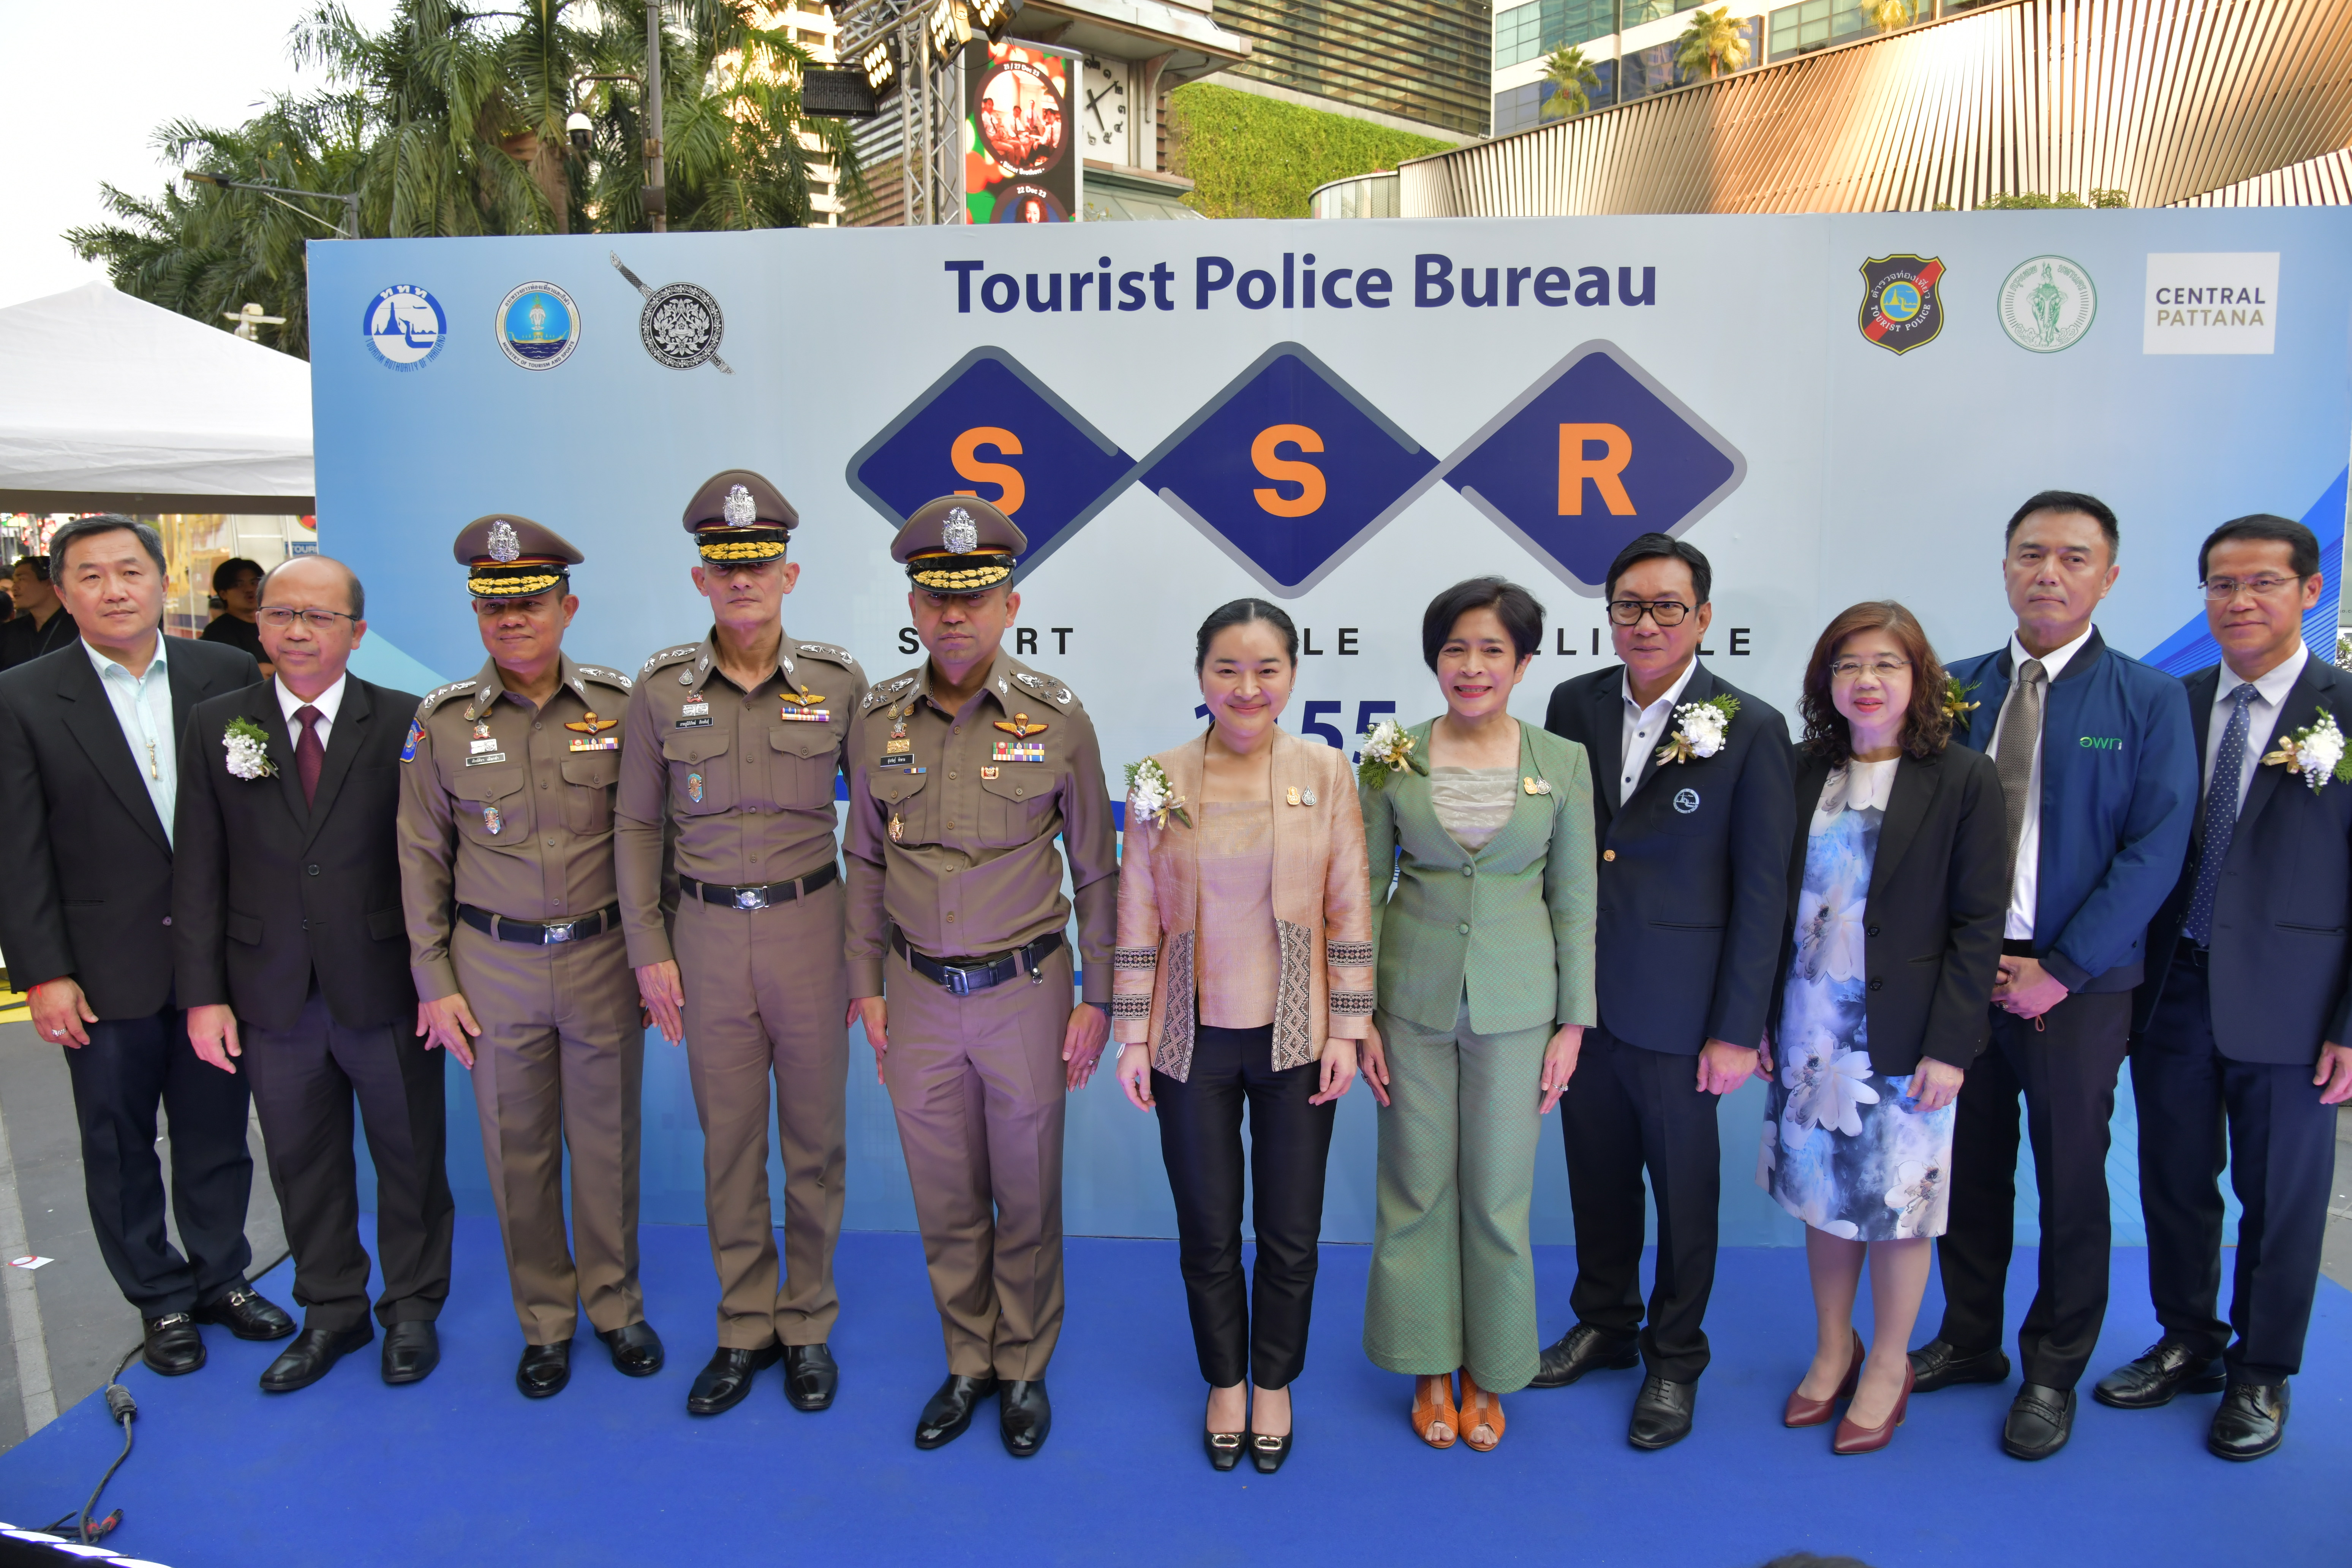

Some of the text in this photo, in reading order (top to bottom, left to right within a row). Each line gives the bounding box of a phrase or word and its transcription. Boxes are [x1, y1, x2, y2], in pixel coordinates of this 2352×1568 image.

[1022, 64, 1032, 73] Dec
[1003, 161, 1018, 173] Bitter
[1026, 186, 1038, 194] Dec
[945, 253, 1655, 313] Tourist Police Bureau
[1871, 270, 1930, 299] ตำรวจท่องเที่ยว
[2156, 288, 2265, 305] CENTRAL
[1871, 304, 1931, 332] TOURIST POLICE
[2157, 310, 2264, 326] PATTANA
[365, 335, 446, 372] TOURISM AUTHORITY OF THAILAND
[502, 342, 520, 362] MINISTRY
[561, 341, 574, 358] SPORTS
[951, 424, 1636, 517] S S R
[898, 627, 1073, 655] SRT
